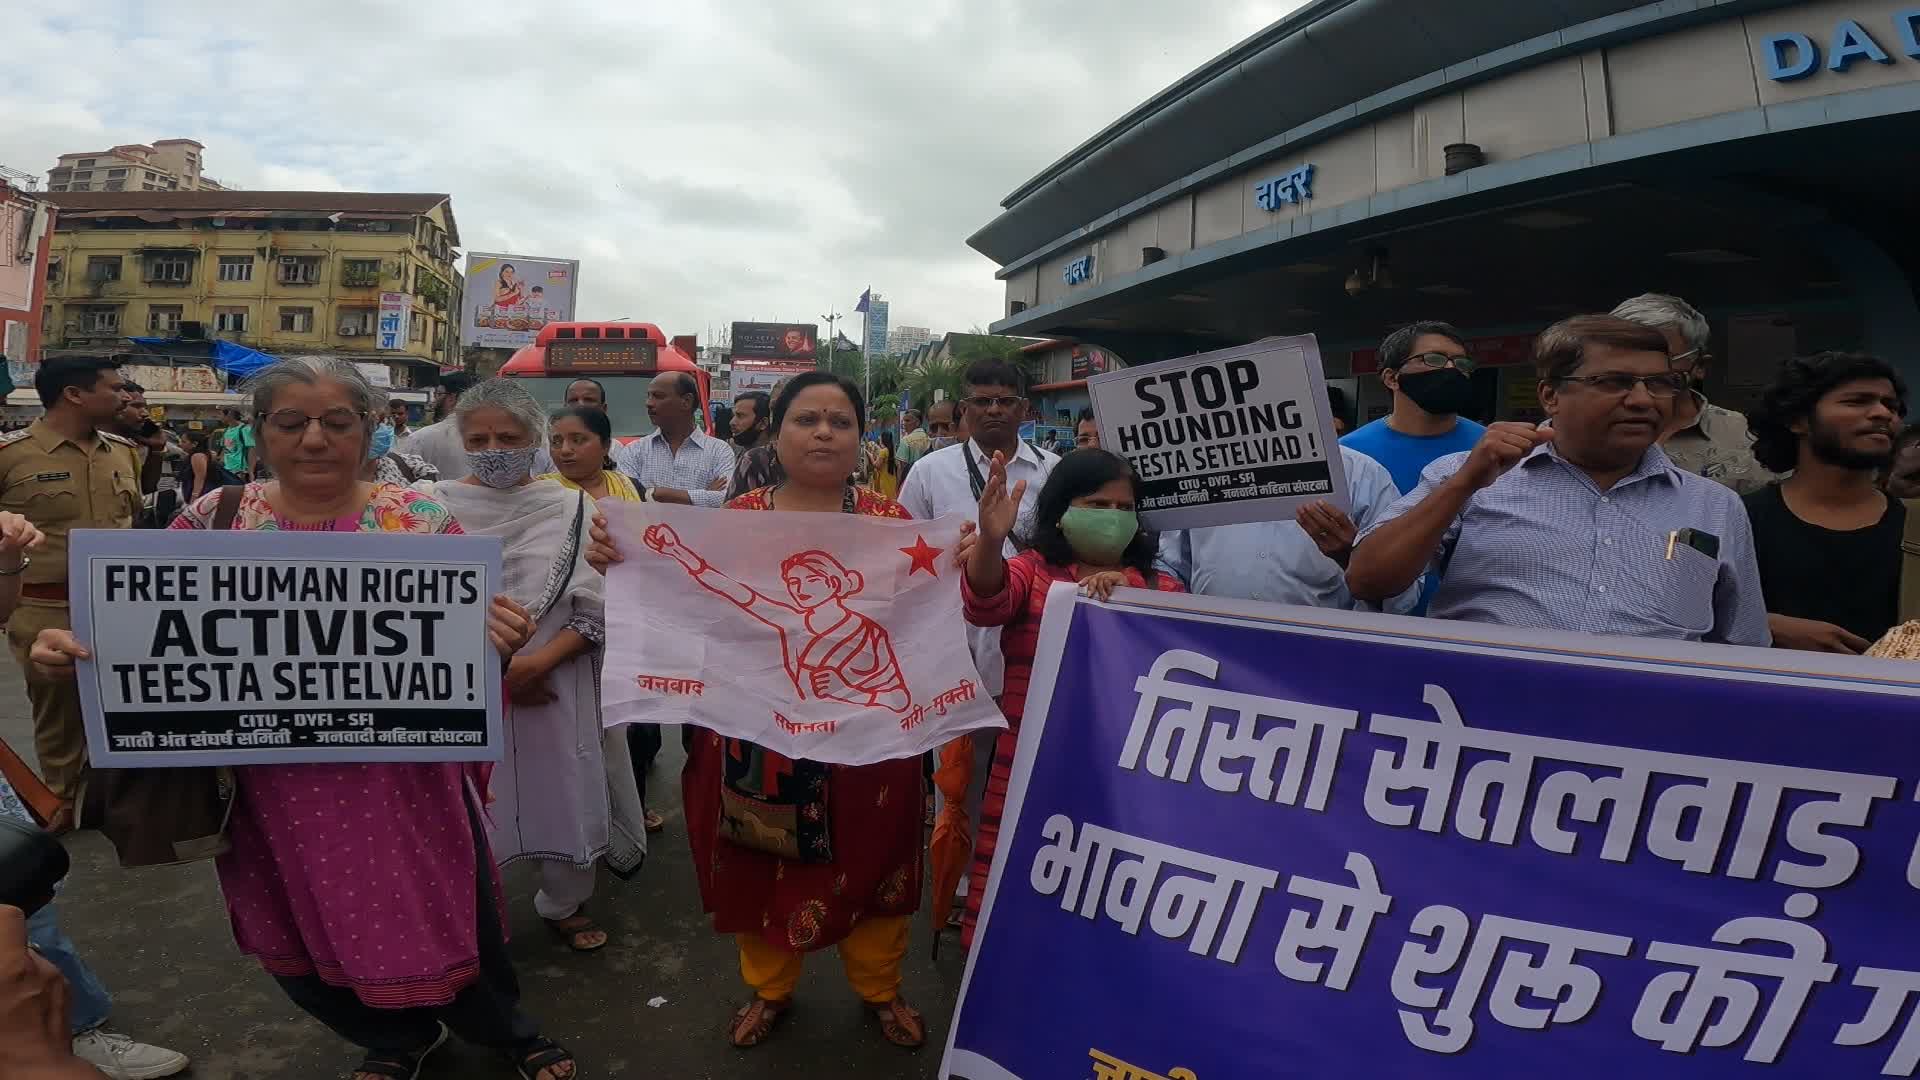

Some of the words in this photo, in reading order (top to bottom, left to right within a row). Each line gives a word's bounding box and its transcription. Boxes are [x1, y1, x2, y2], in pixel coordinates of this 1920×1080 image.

[1256, 164, 1316, 212] दादर
[1134, 360, 1260, 419] STOP
[1118, 400, 1303, 452] HOUNDING
[1129, 450, 1190, 478] EESTA
[1192, 435, 1302, 471] SETELVAD
[1308, 433, 1319, 458] !
[1178, 478, 1200, 491] CITU
[1239, 472, 1256, 484] SFI
[105, 565, 199, 602] FREE
[211, 565, 351, 603] HUMAN
[361, 567, 479, 606] RIGHTS
[150, 608, 446, 658] ACTIVIST
[112, 662, 266, 704] TEESTA
[274, 661, 453, 702] SETELVAD
[465, 662, 475, 702] !
[112, 732, 154, 749] जाती
[158, 731, 186, 747] अंत
[189, 729, 233, 748] संघर्ष
[235, 728, 292, 747] समिती
[313, 727, 375, 745] जनवादी
[376, 727, 428, 744] महिला
[430, 727, 484, 744] संघटना
[239, 713, 278, 728] CITU
[348, 712, 374, 728] SFI
[1118, 649, 1359, 812] तिस्ता
[1363, 683, 1898, 918] सेतलवाड़
[1030, 813, 1280, 965] भावना
[1274, 851, 1393, 991] से
[1631, 916, 1839, 1064] की
